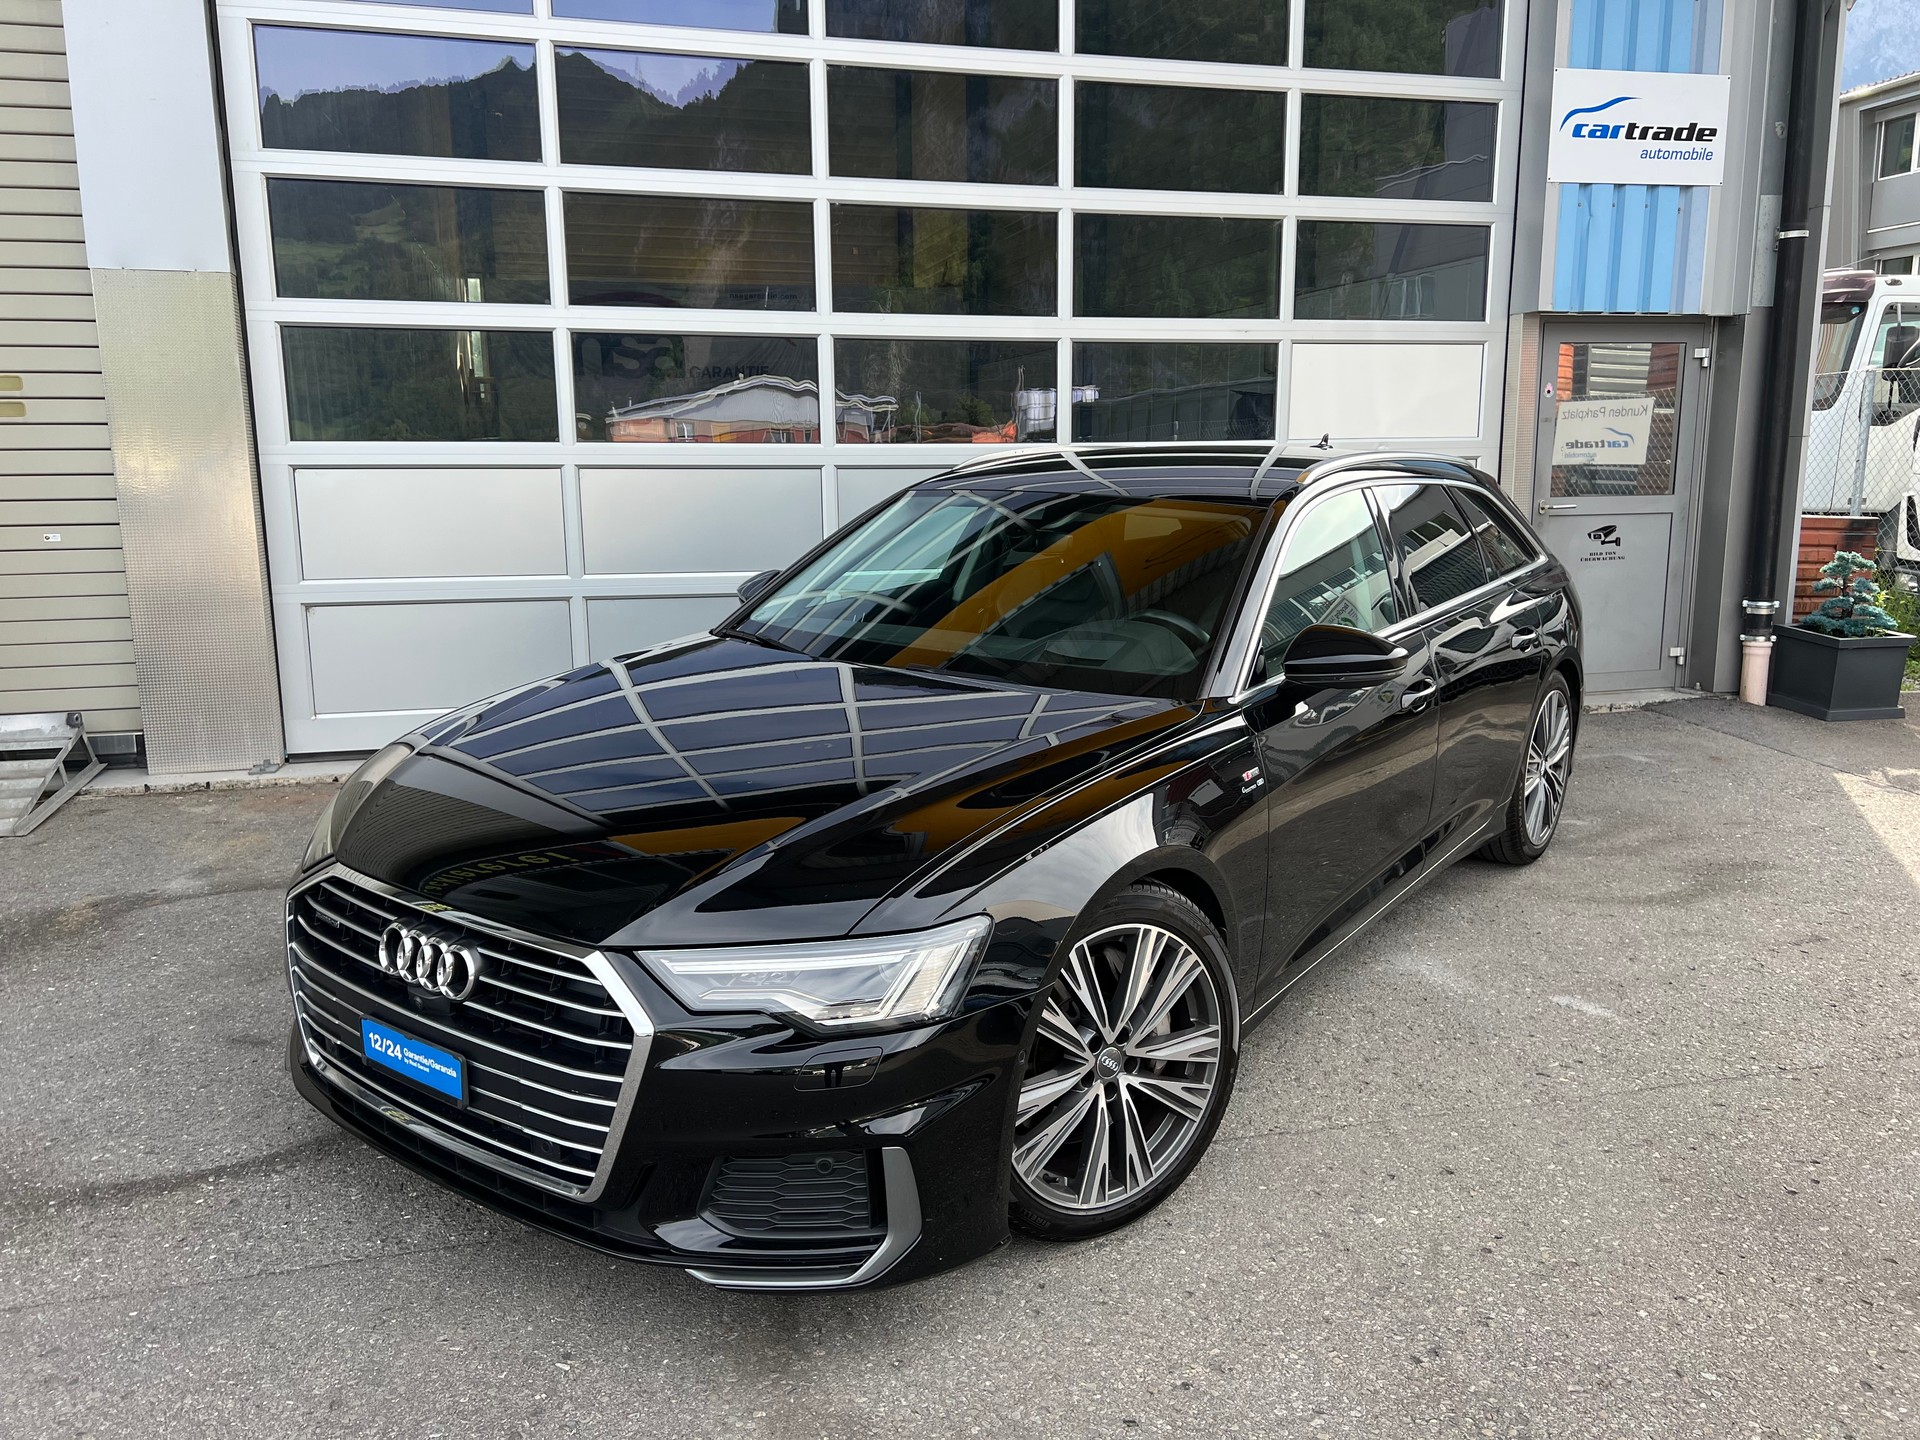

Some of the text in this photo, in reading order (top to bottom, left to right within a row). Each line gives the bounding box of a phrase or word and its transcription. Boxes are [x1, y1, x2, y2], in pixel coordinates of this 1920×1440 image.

[1572, 122, 1718, 142] cartrade
[1640, 147, 1714, 161] automobile
[368, 1032, 403, 1061] 12/24
